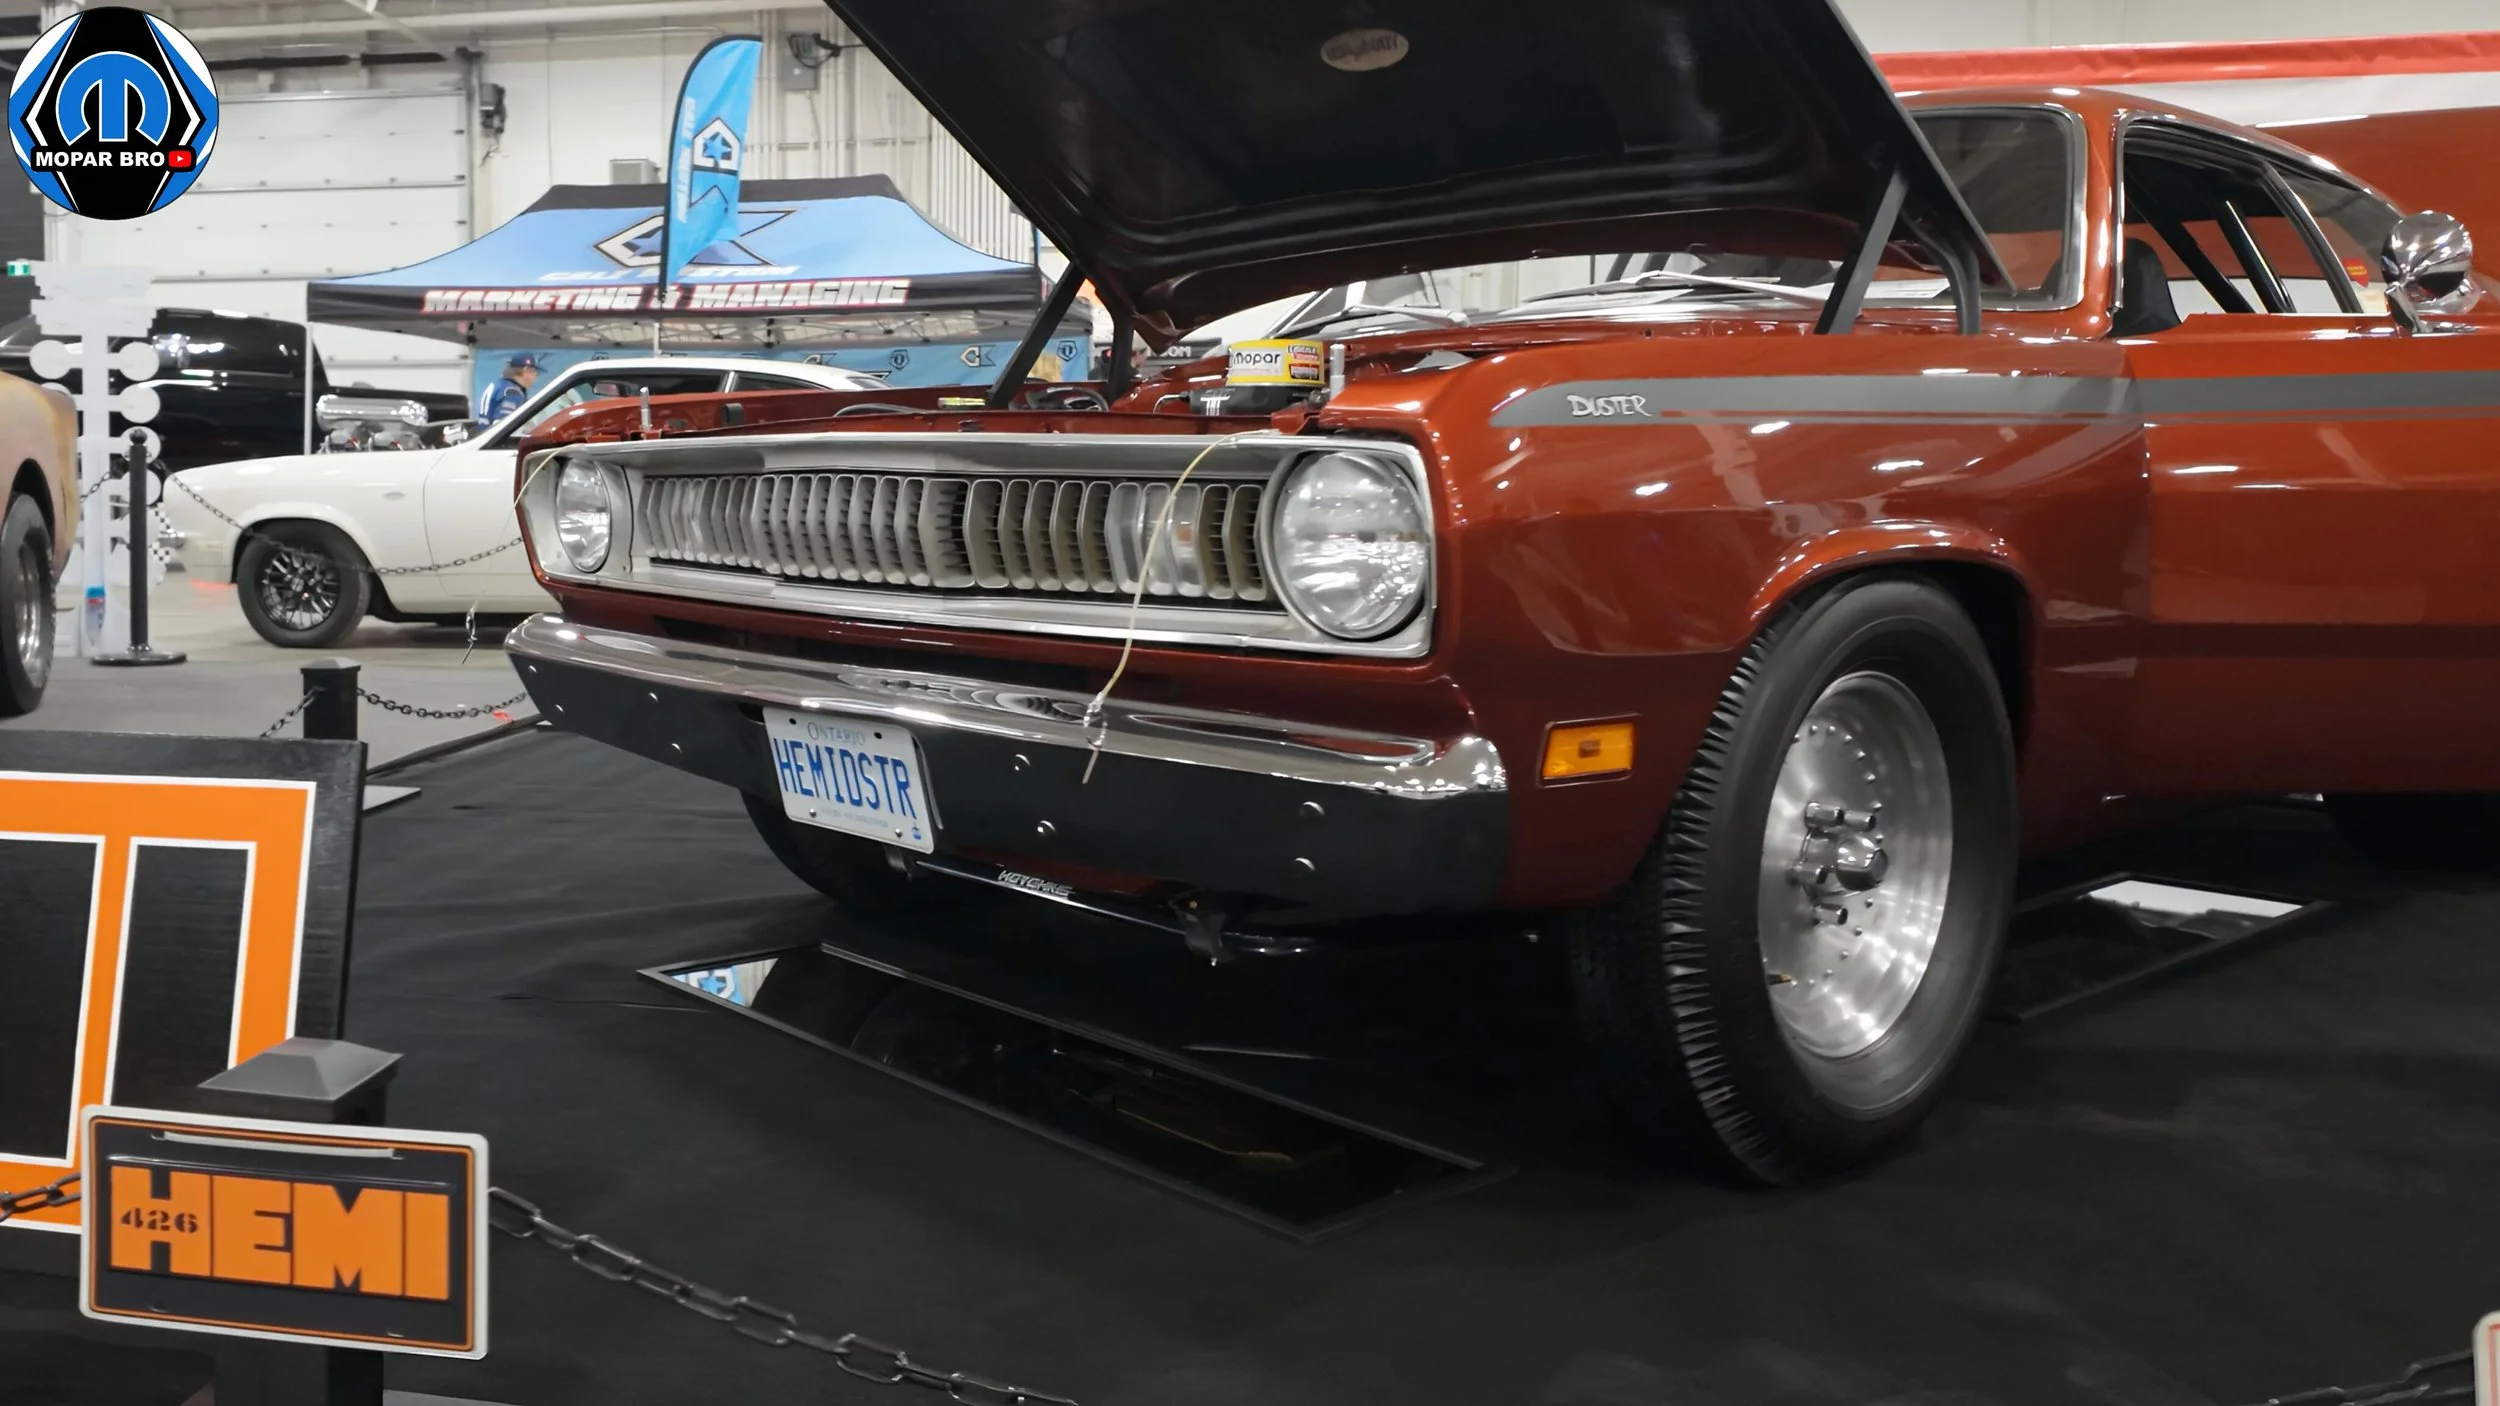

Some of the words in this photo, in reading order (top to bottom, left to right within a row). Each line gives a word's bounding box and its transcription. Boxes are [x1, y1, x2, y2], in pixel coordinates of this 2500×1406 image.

[421, 286, 644, 312] MARKETING
[687, 278, 911, 309] MANAGING
[1566, 394, 1652, 417] DUSTER
[807, 721, 866, 746] ONTARIO
[773, 738, 917, 820] HEMIDSTR
[110, 1165, 450, 1301] HEMI
[120, 1209, 198, 1235] 426
